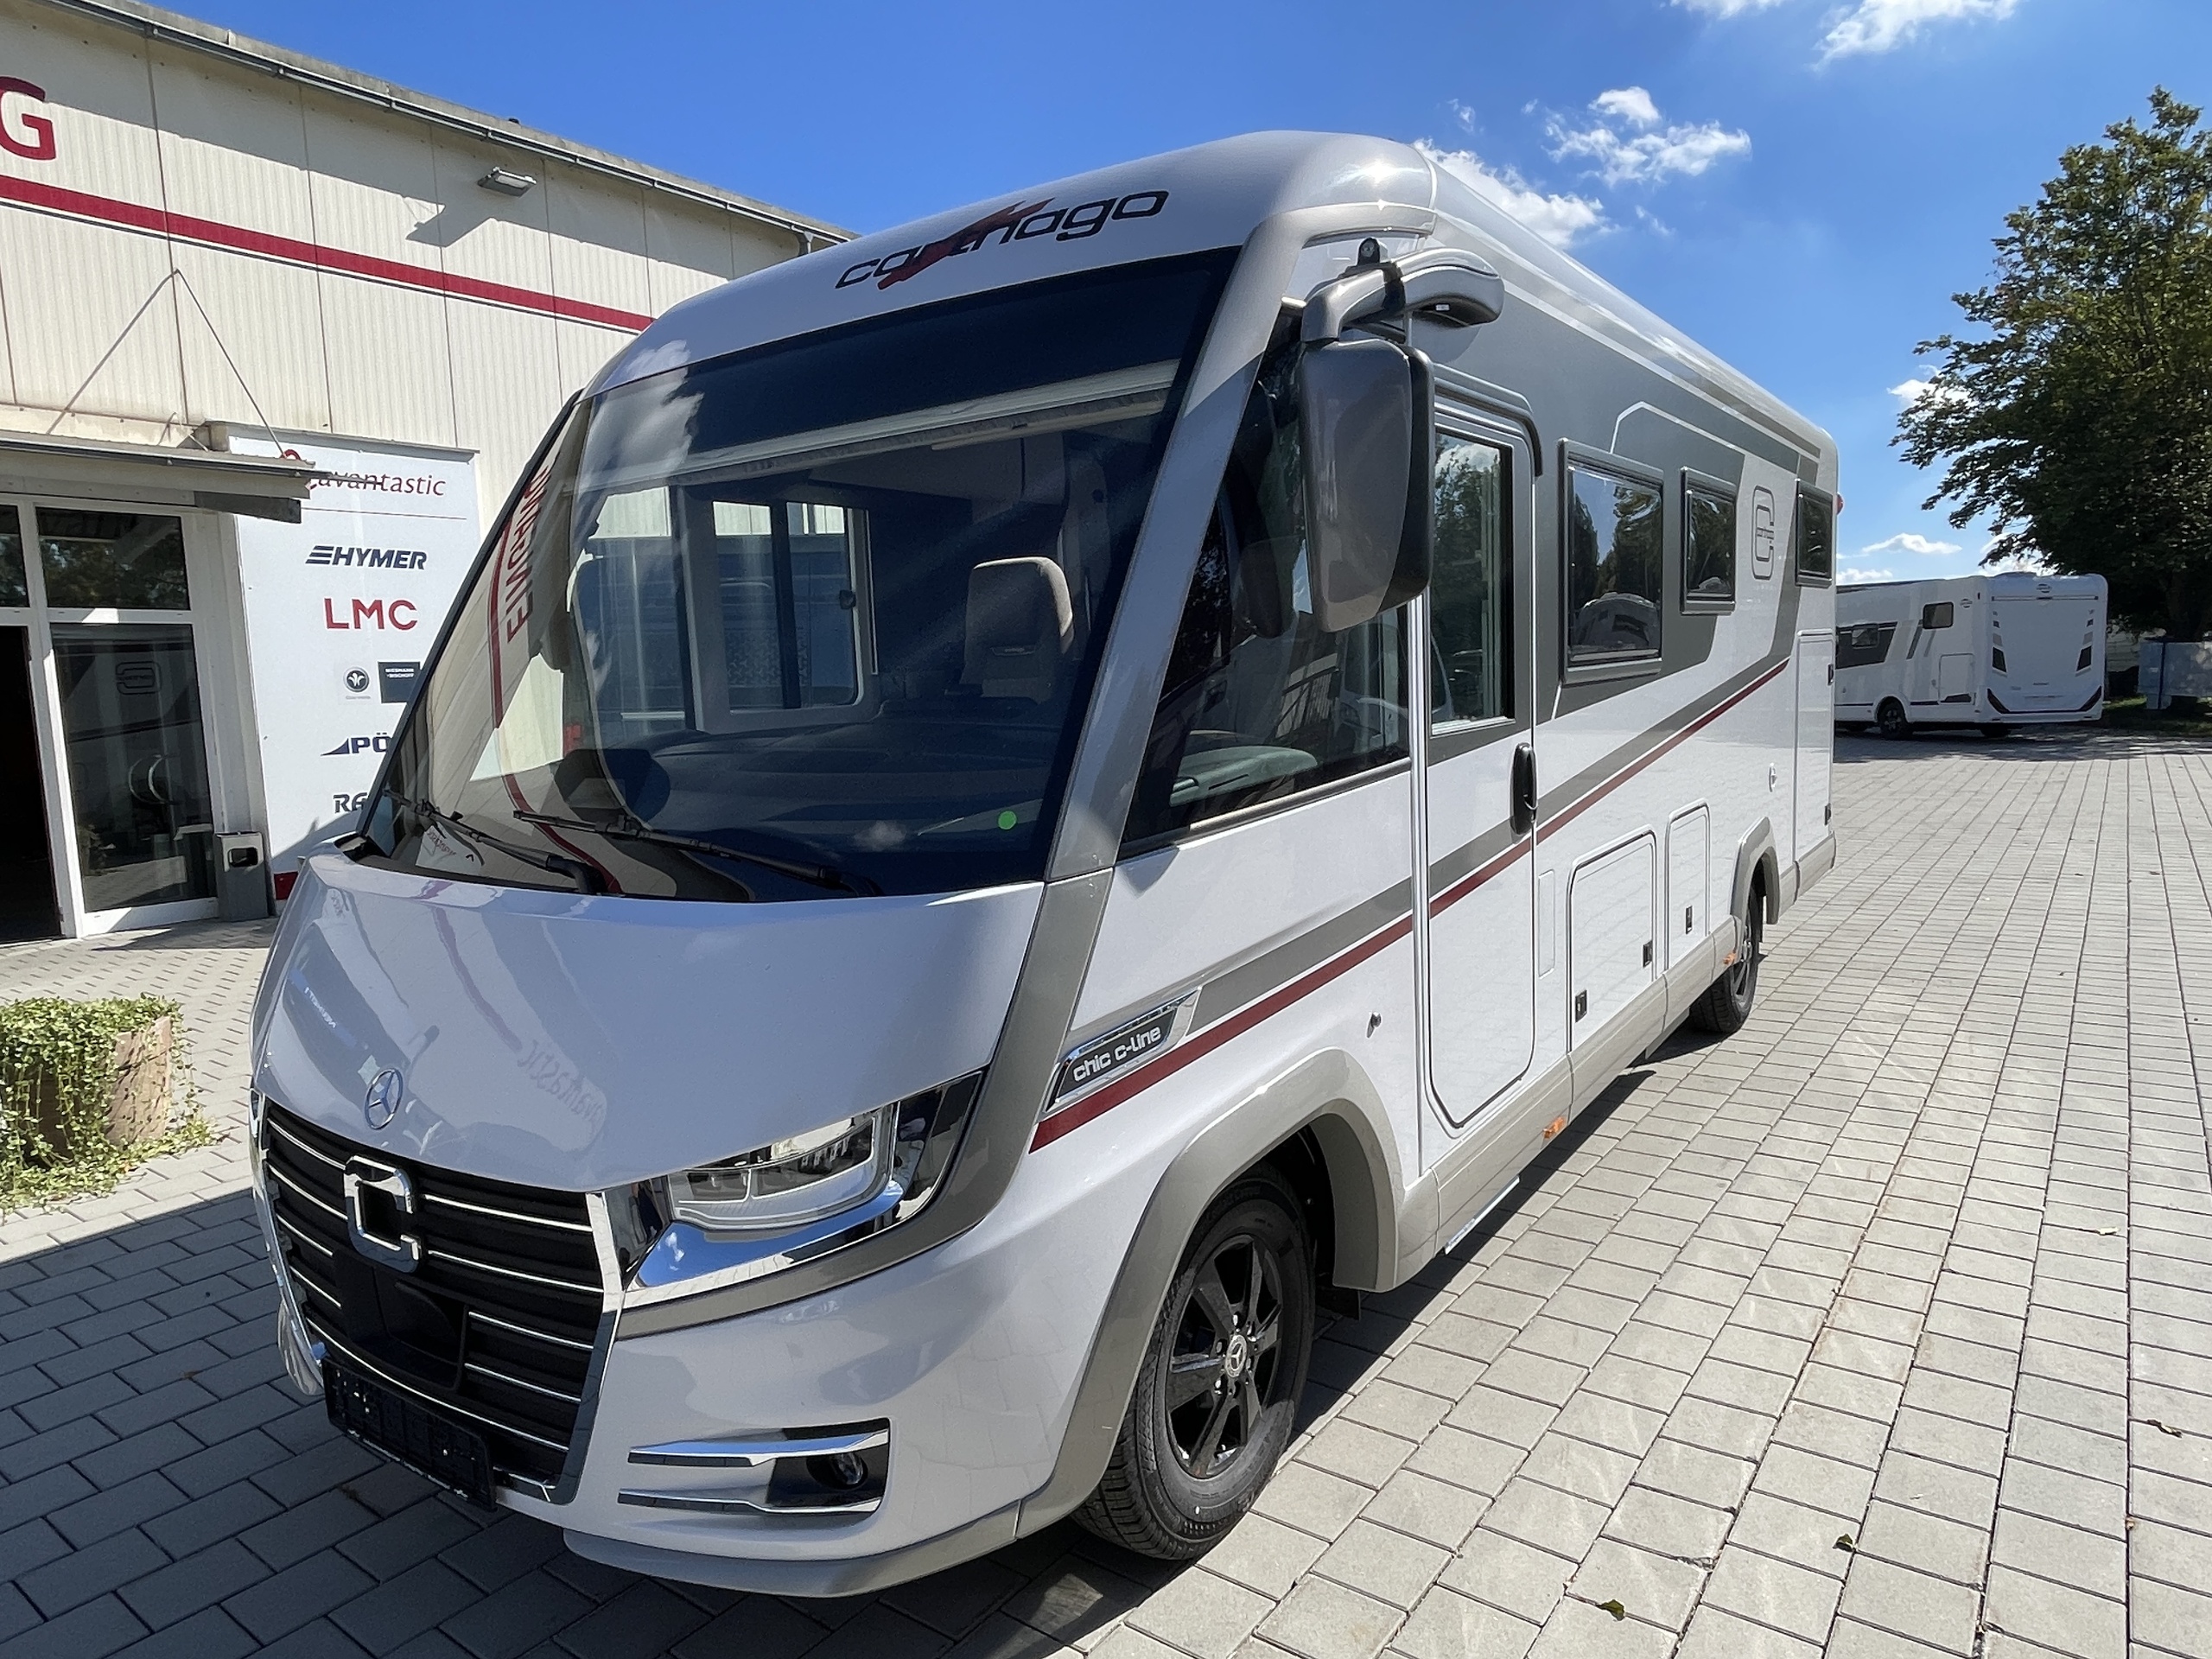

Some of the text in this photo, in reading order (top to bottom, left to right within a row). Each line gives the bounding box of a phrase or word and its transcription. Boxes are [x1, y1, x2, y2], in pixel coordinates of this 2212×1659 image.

[332, 546, 428, 570] HYMER
[324, 598, 417, 631] LMC
[1073, 1027, 1162, 1082] chic c-line
